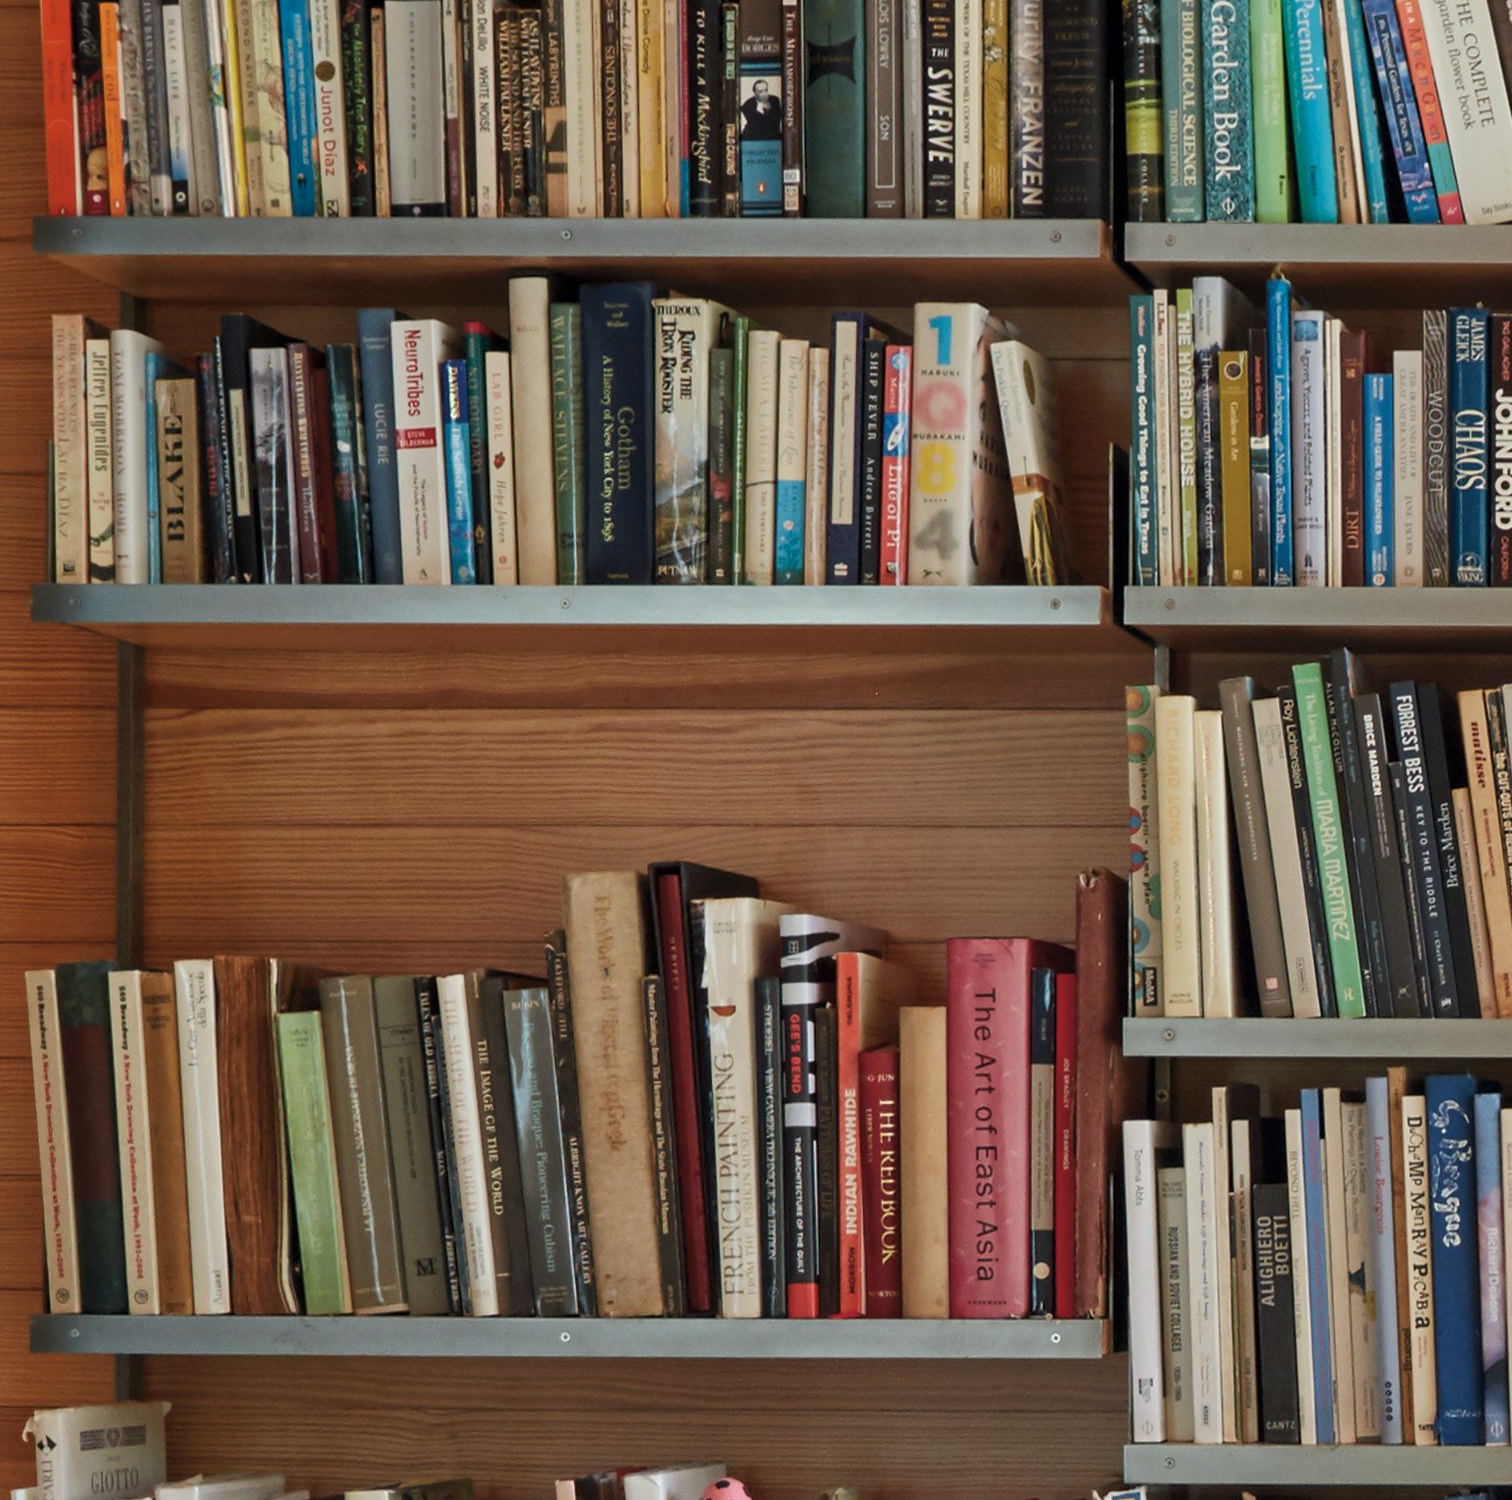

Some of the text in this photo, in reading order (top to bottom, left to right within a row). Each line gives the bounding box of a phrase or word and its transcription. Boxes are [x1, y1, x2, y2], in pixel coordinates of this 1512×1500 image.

[548, 32, 560, 106] LABYRINTHS
[879, 28, 889, 69] LOWRY
[1210, 0, 1239, 101] Garden
[1444, 48, 1462, 93] flower
[1457, 95, 1475, 130] book
[1462, 33, 1495, 127] COMPLETE
[320, 86, 339, 176] Junot Díaz
[880, 115, 890, 140] SON
[928, 67, 952, 163] SWERVE
[1021, 80, 1043, 205] FRANZEN
[1214, 111, 1239, 180] Book
[405, 329, 424, 417] NeuroTribes
[1456, 315, 1470, 362] GLEICK
[1469, 317, 1484, 361] JAMES
[867, 351, 879, 440] SHIP FEVER
[602, 356, 614, 542] A History of New York City to 1898
[616, 406, 636, 490] Gotham
[1455, 409, 1485, 490] CHAOS
[1396, 695, 1425, 793] FORREST BESS
[790, 1014, 802, 1093] GEE'S BEND
[974, 988, 997, 1281] The Art of East Asia
